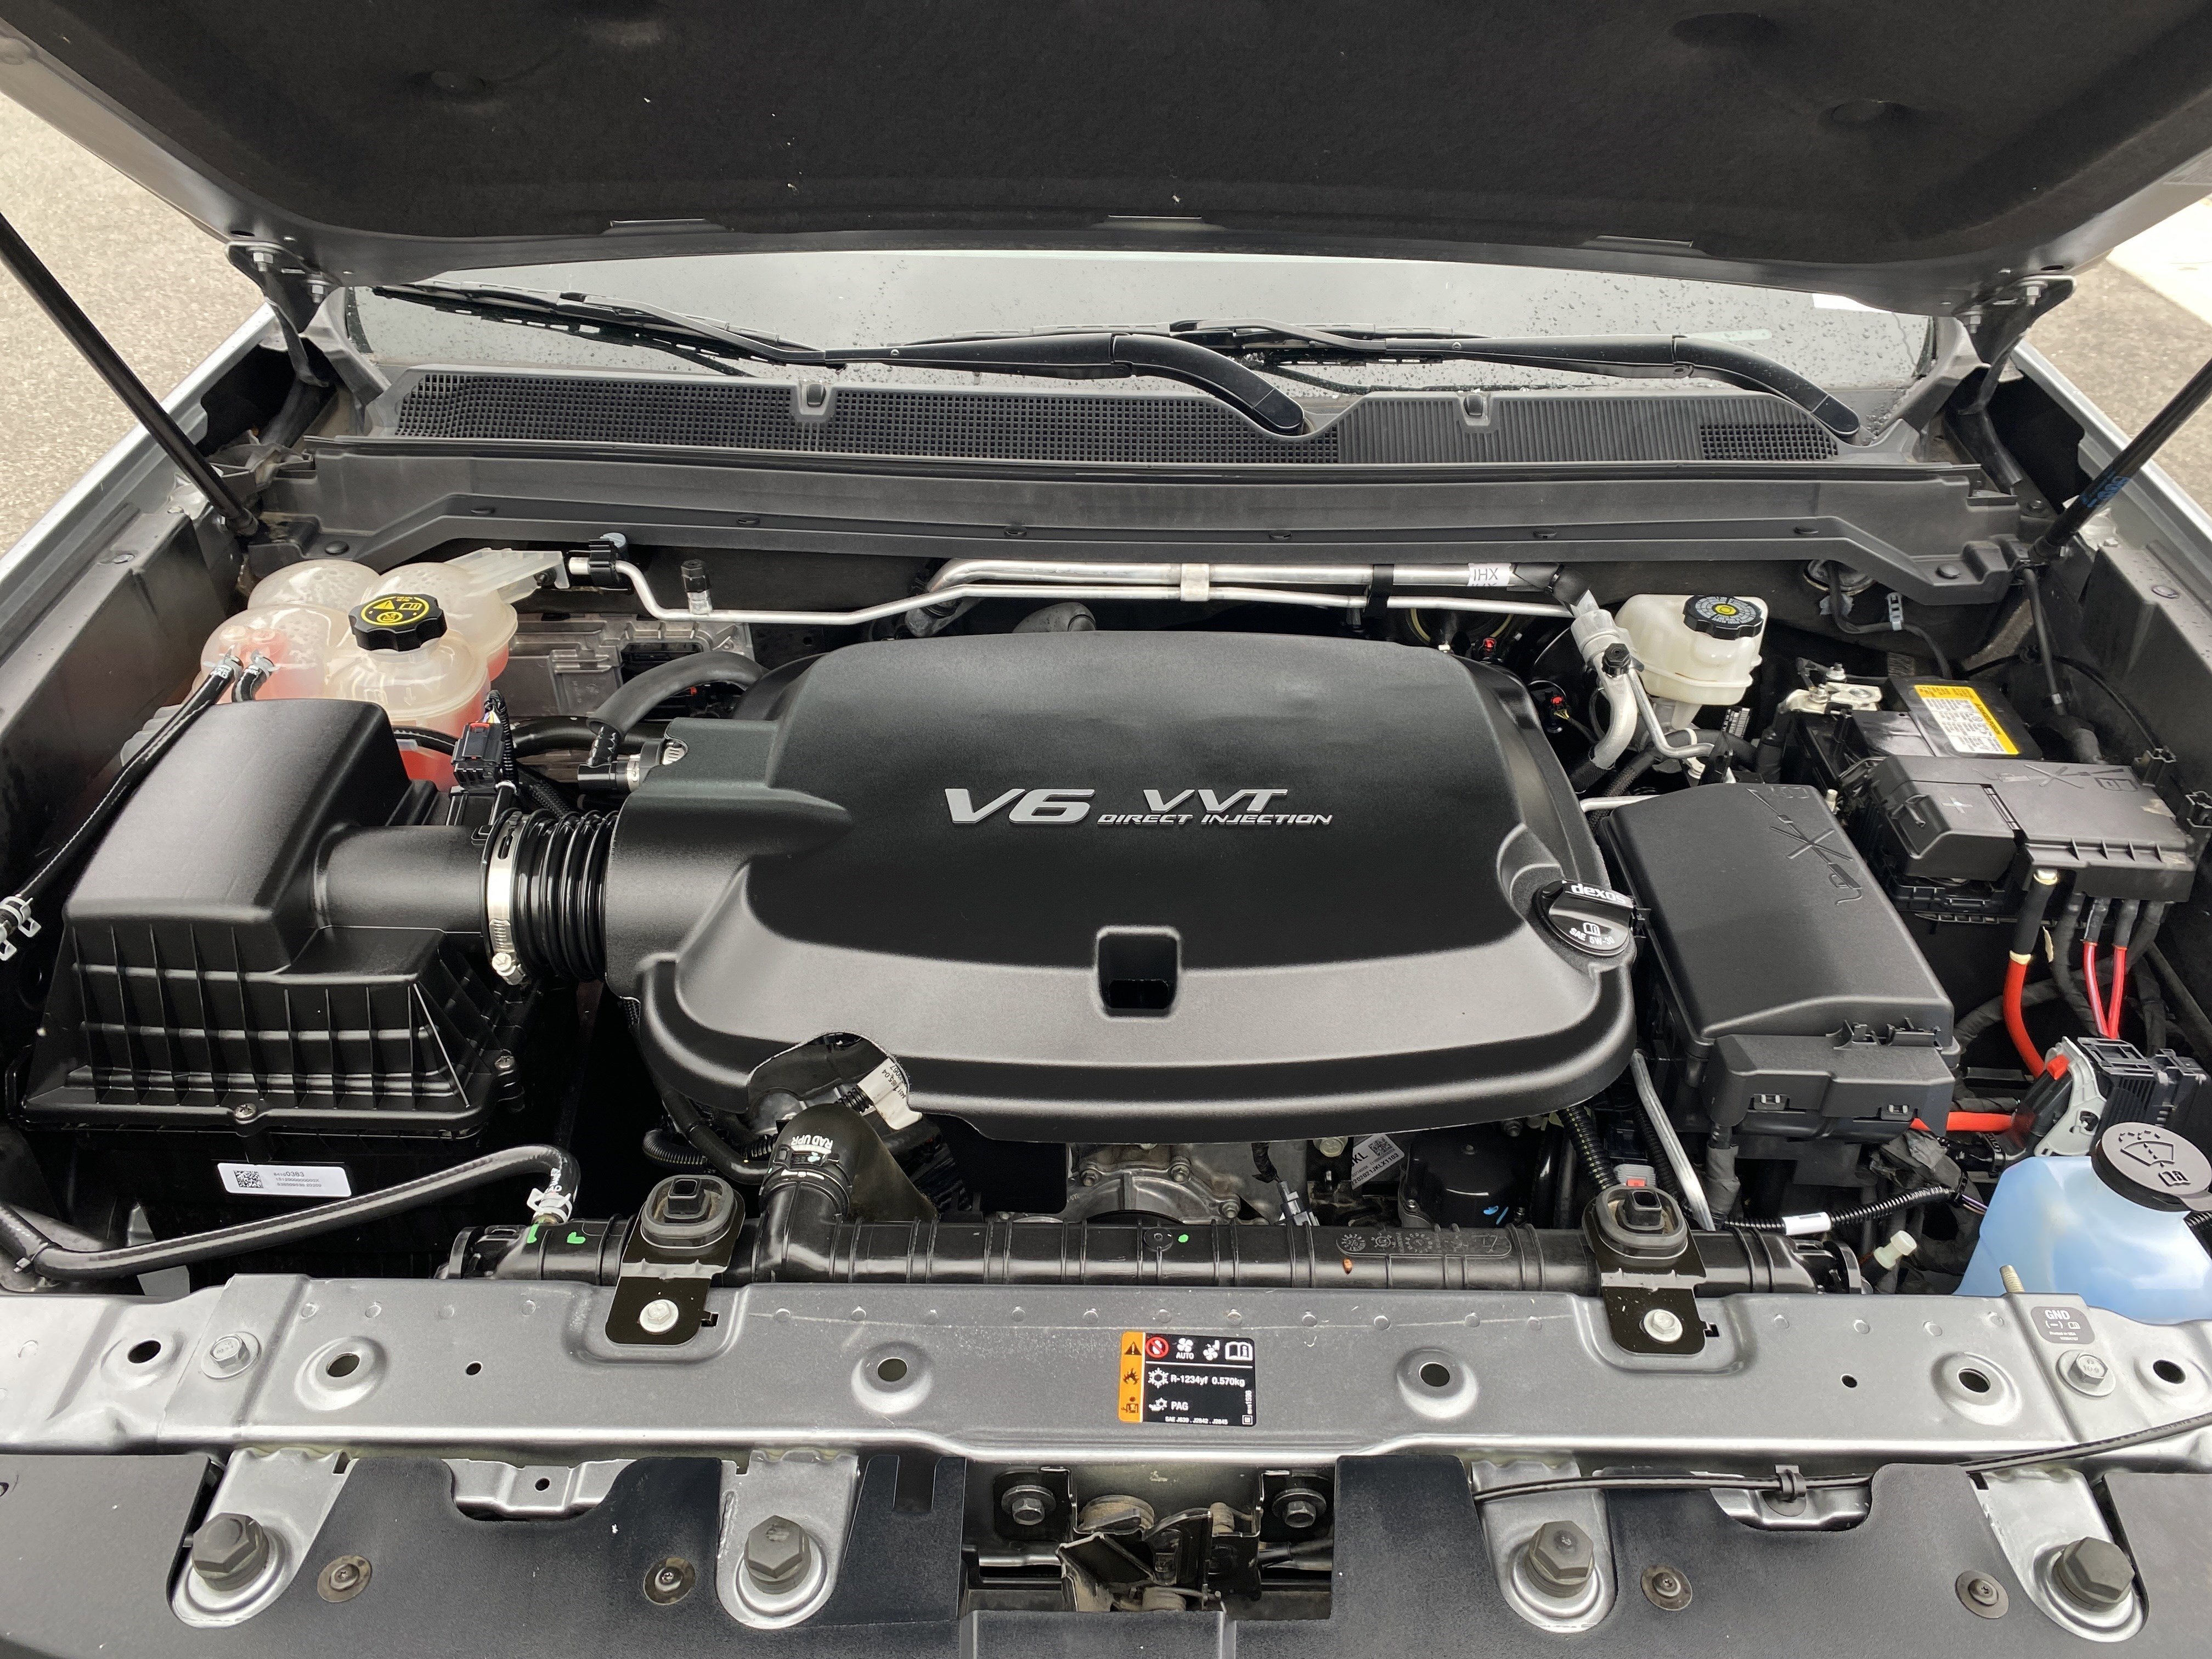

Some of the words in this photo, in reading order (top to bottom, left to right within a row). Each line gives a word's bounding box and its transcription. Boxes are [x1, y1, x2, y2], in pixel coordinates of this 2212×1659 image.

[945, 788, 1095, 823] V6
[1143, 789, 1288, 813] VVT
[1097, 814, 1193, 825] DIRECT
[1201, 814, 1333, 825] INJECTION
[1571, 883, 1626, 904] dexos
[1569, 927, 1587, 941] SAE
[1589, 935, 1615, 945] 5W-30
[791, 1134, 811, 1146] UPR
[812, 1135, 833, 1150] RAD
[2045, 1310, 2070, 1320] GND
[1176, 1352, 1194, 1360] AUTO
[1170, 1374, 1208, 1386] R-1234yf
[1211, 1377, 1245, 1388] 0.570kg
[1171, 1401, 1189, 1411] PAG
